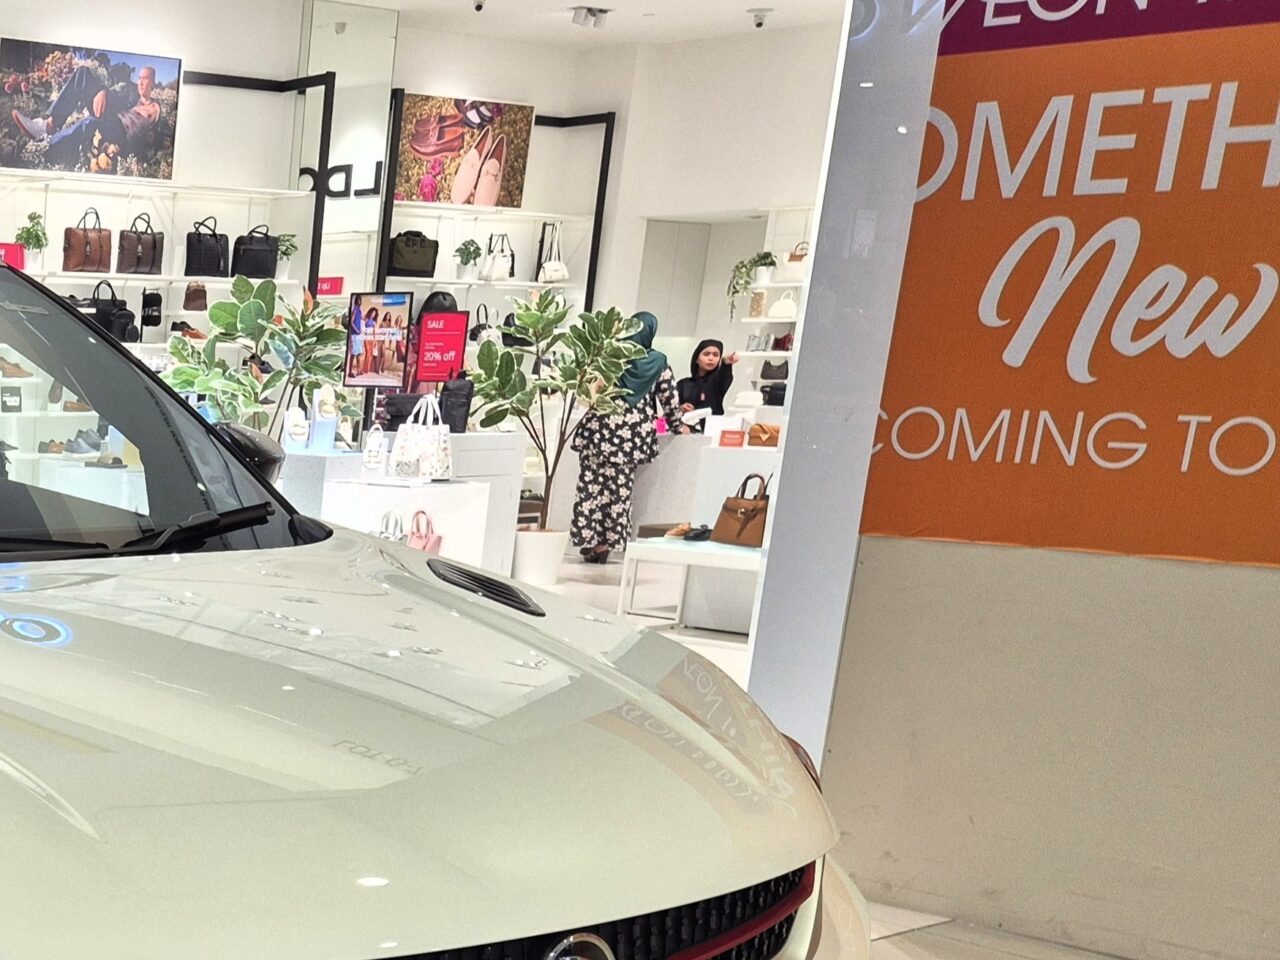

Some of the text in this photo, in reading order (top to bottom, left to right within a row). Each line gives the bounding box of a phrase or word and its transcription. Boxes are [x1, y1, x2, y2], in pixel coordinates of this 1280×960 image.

[978, 216, 1280, 384] New
[426, 319, 445, 329] SALE
[423, 350, 456, 362] 20% off
[1177, 415, 1277, 476] TO
